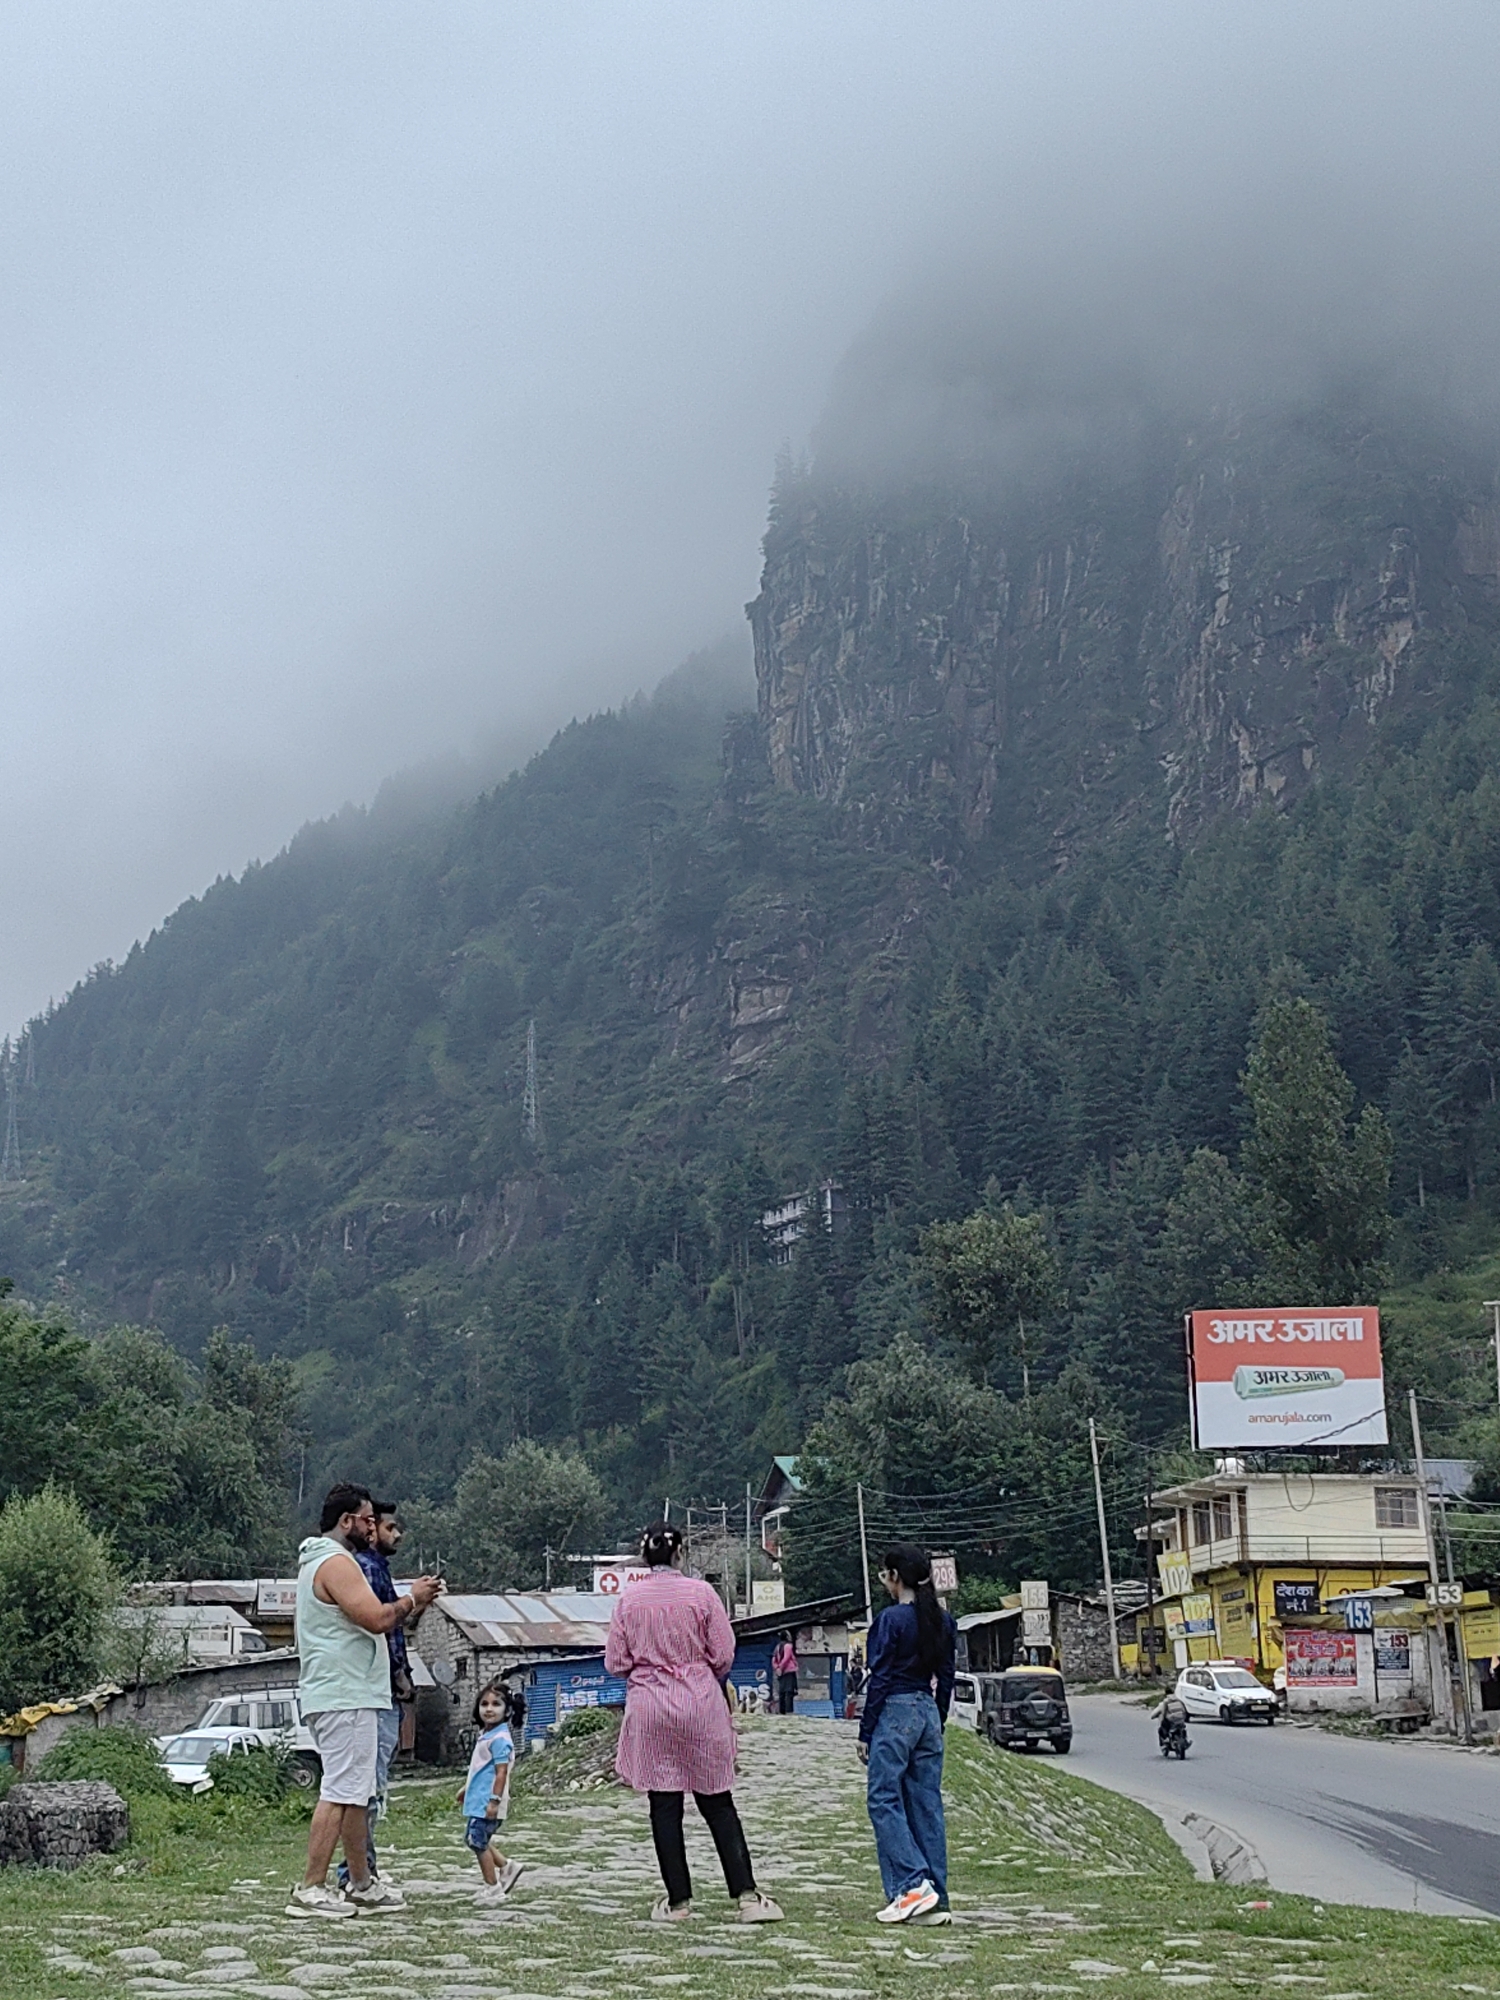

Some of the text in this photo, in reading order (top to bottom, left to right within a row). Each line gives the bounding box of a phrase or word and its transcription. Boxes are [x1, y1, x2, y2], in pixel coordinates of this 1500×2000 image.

[1207, 1317, 1363, 1343] अमर उजाला
[1253, 1370, 1331, 1385] अमर उजाला
[1248, 1411, 1332, 1426] amarujala.com
[933, 1566, 956, 1590] 298
[1161, 1565, 1190, 1595] 102
[1276, 1583, 1315, 1597] देश का
[1426, 1584, 1463, 1606] 153
[1346, 1600, 1373, 1629] 153
[1389, 1634, 1409, 1648] 153
